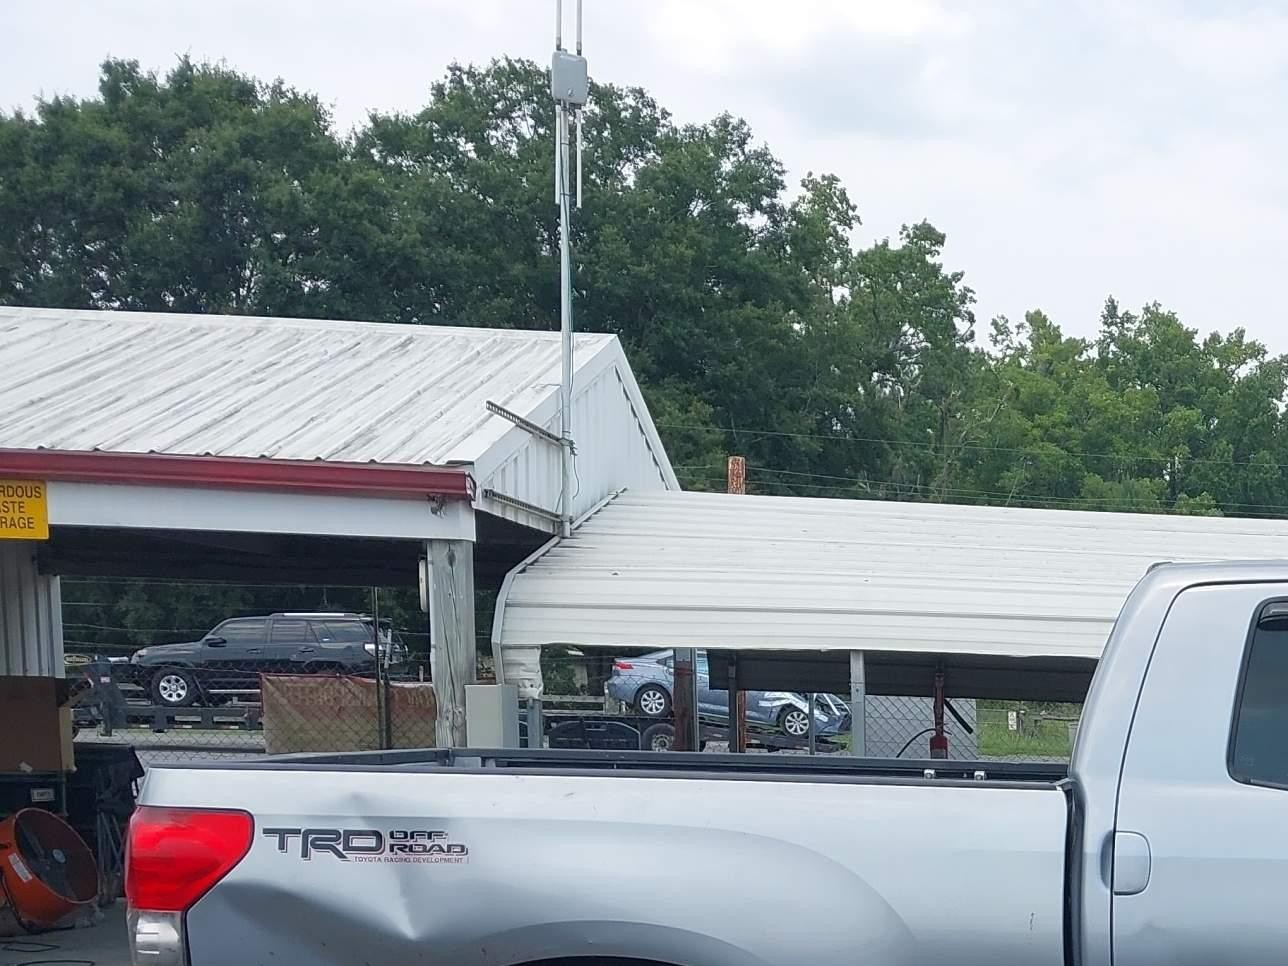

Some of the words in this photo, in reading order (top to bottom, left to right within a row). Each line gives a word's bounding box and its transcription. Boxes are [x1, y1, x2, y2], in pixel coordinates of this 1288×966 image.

[0, 501, 25, 513] STE
[389, 830, 448, 843] OFF
[262, 828, 385, 862] TRD
[389, 843, 469, 856] ROAD
[354, 856, 382, 864] TOYOTA
